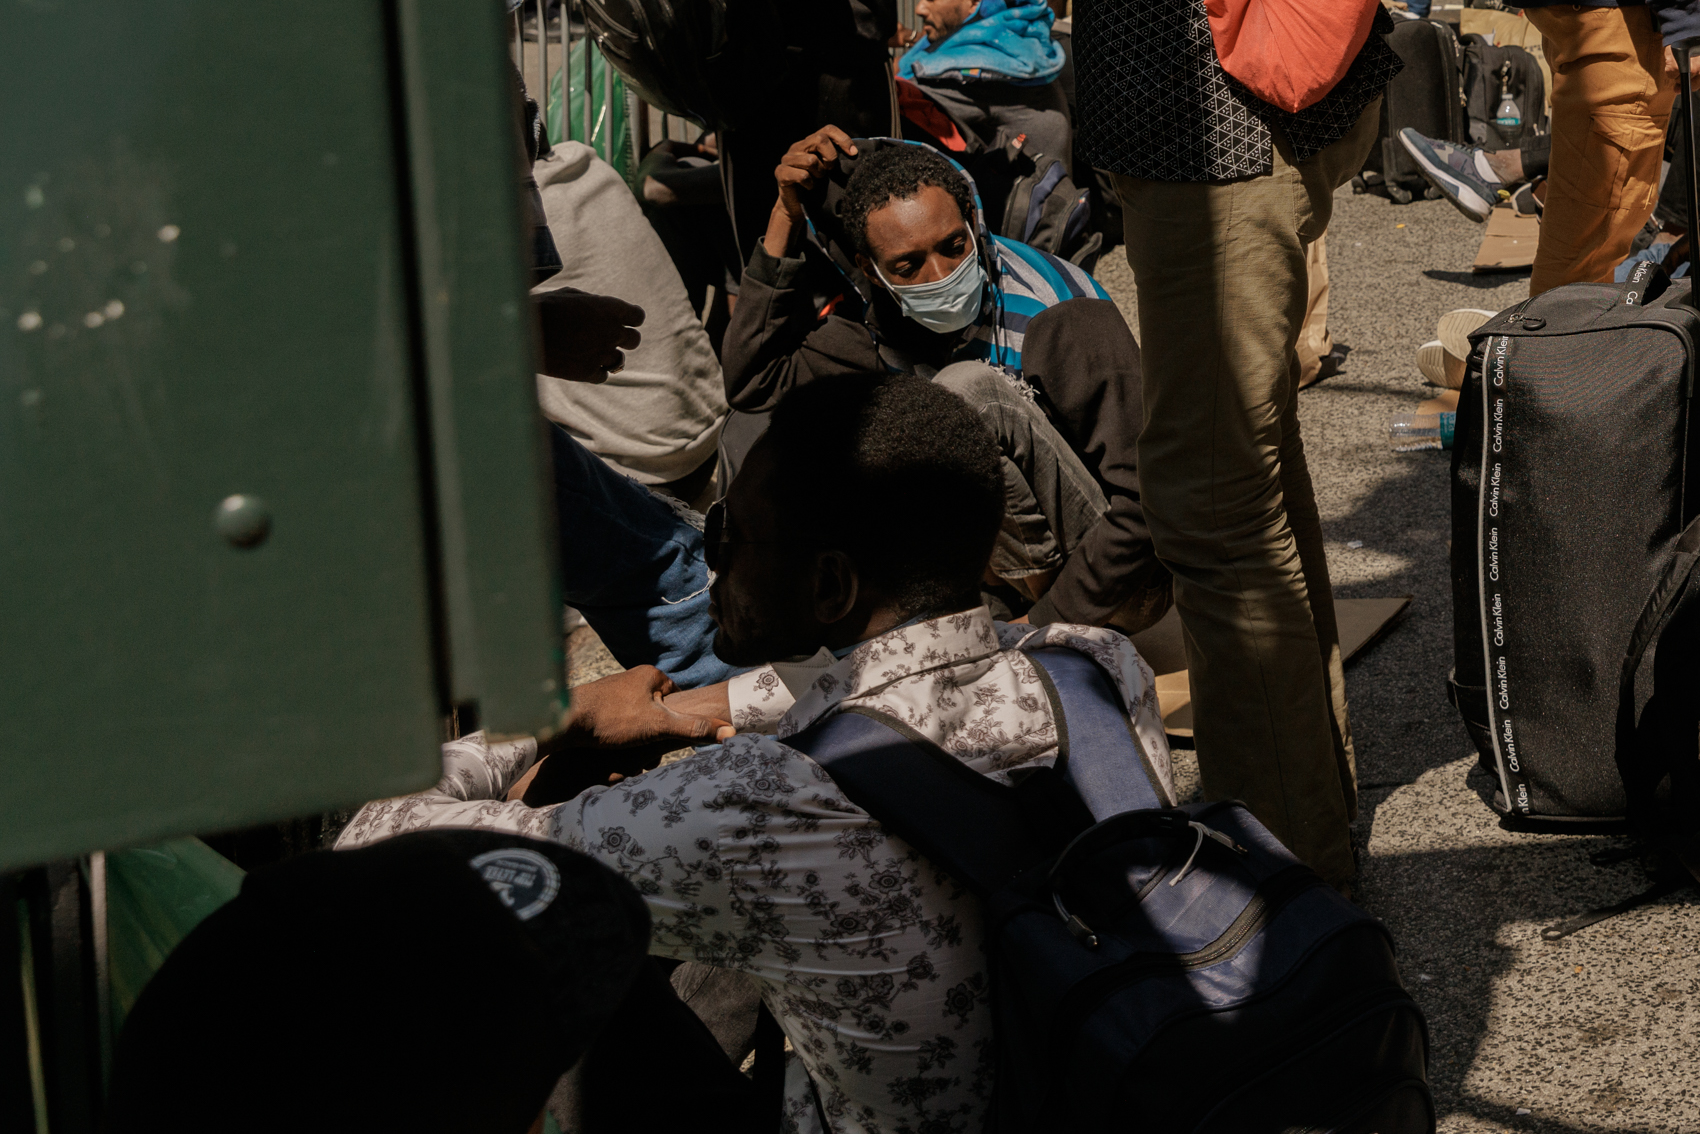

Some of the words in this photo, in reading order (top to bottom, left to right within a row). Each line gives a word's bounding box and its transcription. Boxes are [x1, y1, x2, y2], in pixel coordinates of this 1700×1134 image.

[1493, 355, 1505, 387] Calvin
[1494, 398, 1504, 422] Klein
[1493, 422, 1503, 453] Calvin
[1491, 462, 1502, 486] Klein
[1489, 486, 1500, 517] Calvin
[1489, 527, 1498, 551] Klein
[1489, 551, 1499, 582] Calvin
[1492, 593, 1501, 616] Klein
[1493, 616, 1503, 647] Calvin
[1498, 656, 1506, 679] Klein
[1499, 679, 1509, 710] Calvin
[1503, 719, 1514, 743] Klein
[1506, 742, 1520, 772] Calvin
[1516, 783, 1529, 808] Klein
